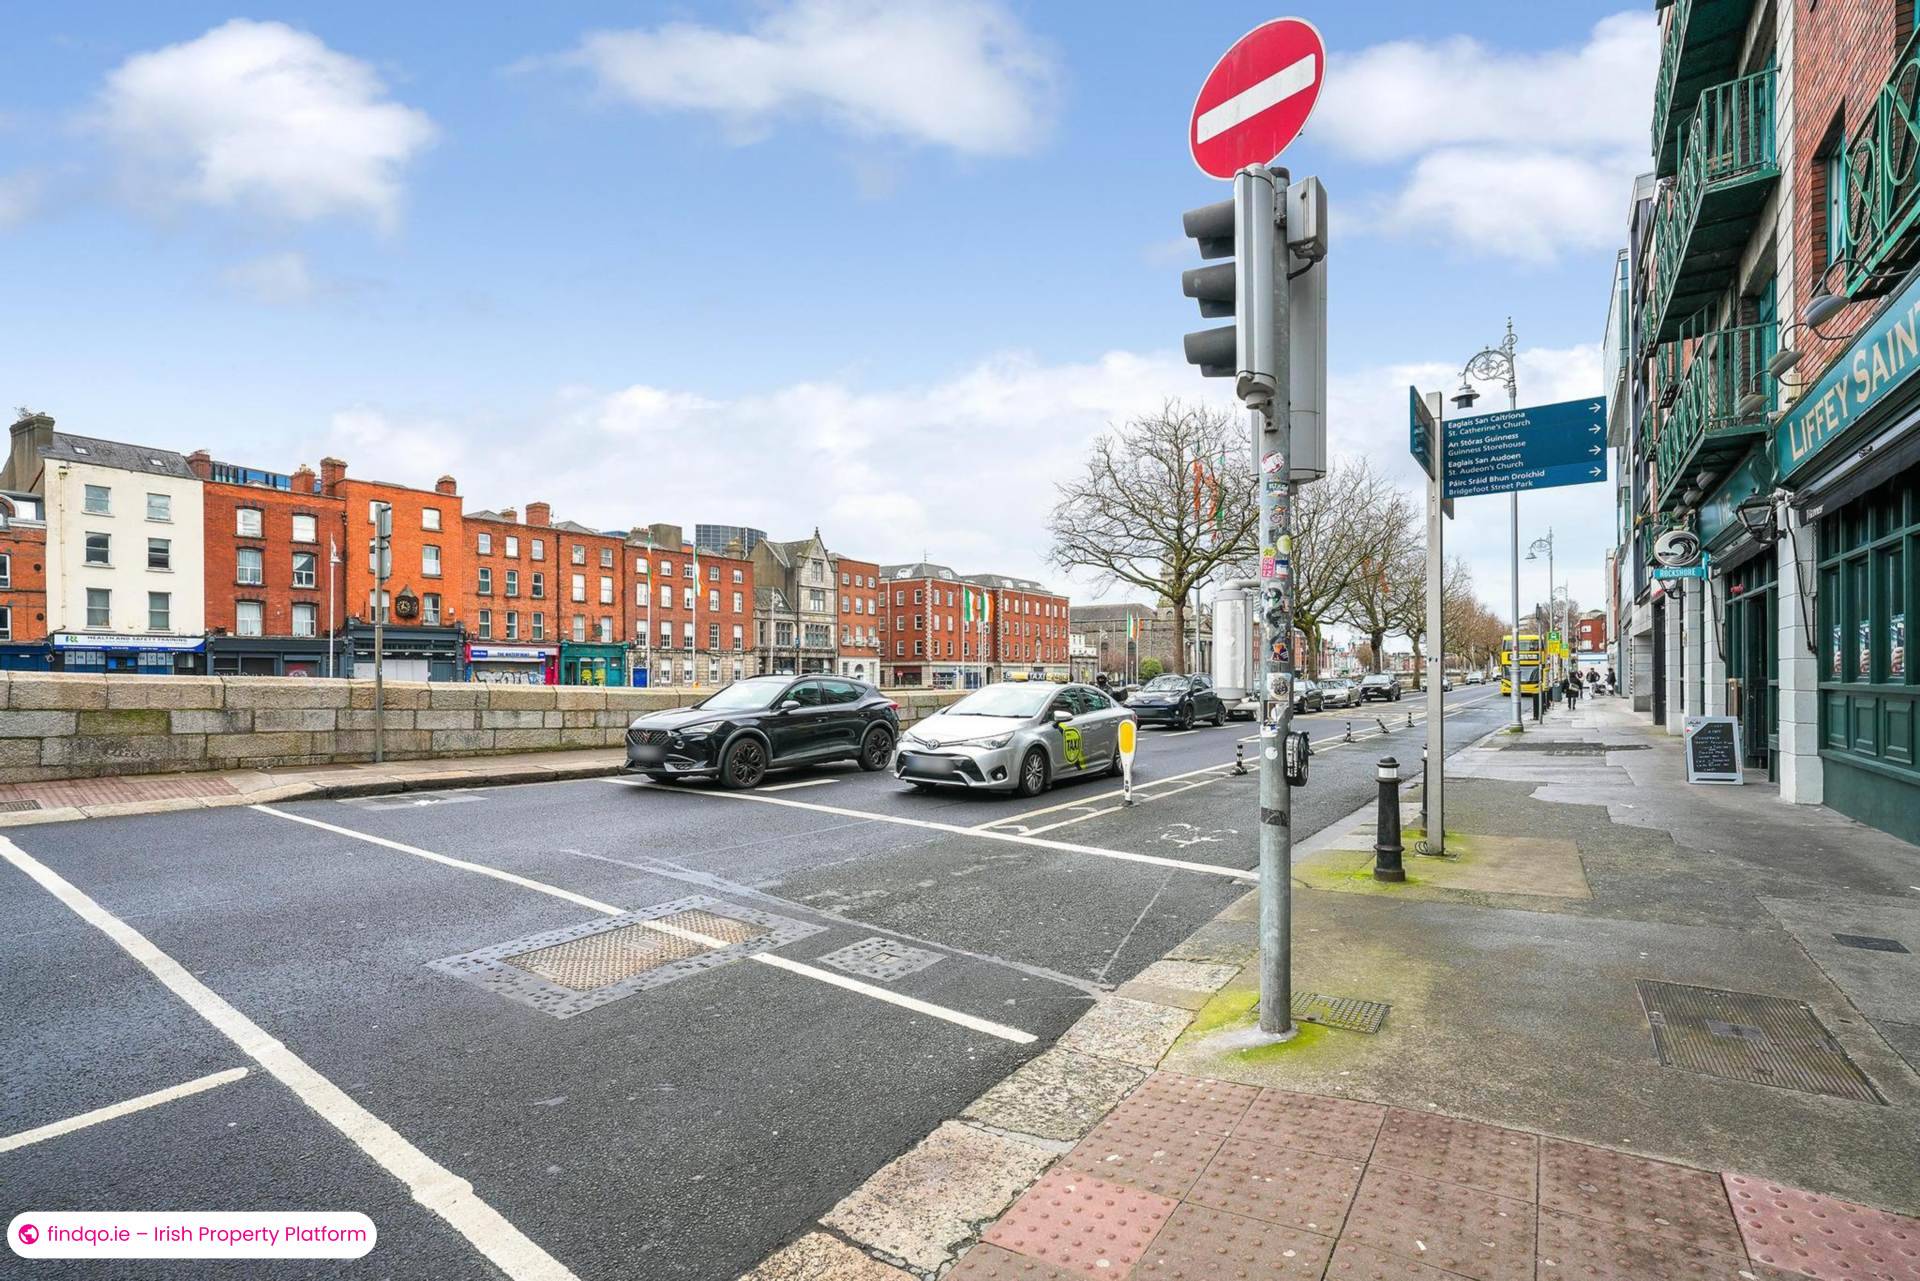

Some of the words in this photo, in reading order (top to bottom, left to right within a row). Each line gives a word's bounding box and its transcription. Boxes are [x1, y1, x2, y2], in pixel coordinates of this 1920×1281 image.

[1789, 376, 1848, 462] LIFFEY
[1853, 300, 1920, 403] SAIN
[1448, 420, 1473, 429] Eaglais
[1460, 424, 1500, 435] Catherine's
[1503, 420, 1530, 429] Church
[1484, 433, 1519, 443] Guinness
[1448, 447, 1481, 456] Guinness
[1483, 441, 1526, 451] Storehouse
[1448, 459, 1473, 468] Eaglais
[1490, 453, 1521, 462] Audoen
[1496, 461, 1524, 470] Church
[1468, 477, 1487, 485] Sráid
[1489, 475, 1509, 483] Bhun
[1511, 470, 1544, 480] Droichid
[1449, 486, 1489, 495] Bridgefoot
[1490, 482, 1514, 490] Street
[1516, 480, 1533, 488] Park
[1660, 568, 1696, 577] ROCKSHORE
[1029, 672, 1046, 681] TAXI
[1066, 738, 1081, 752] TAXI
